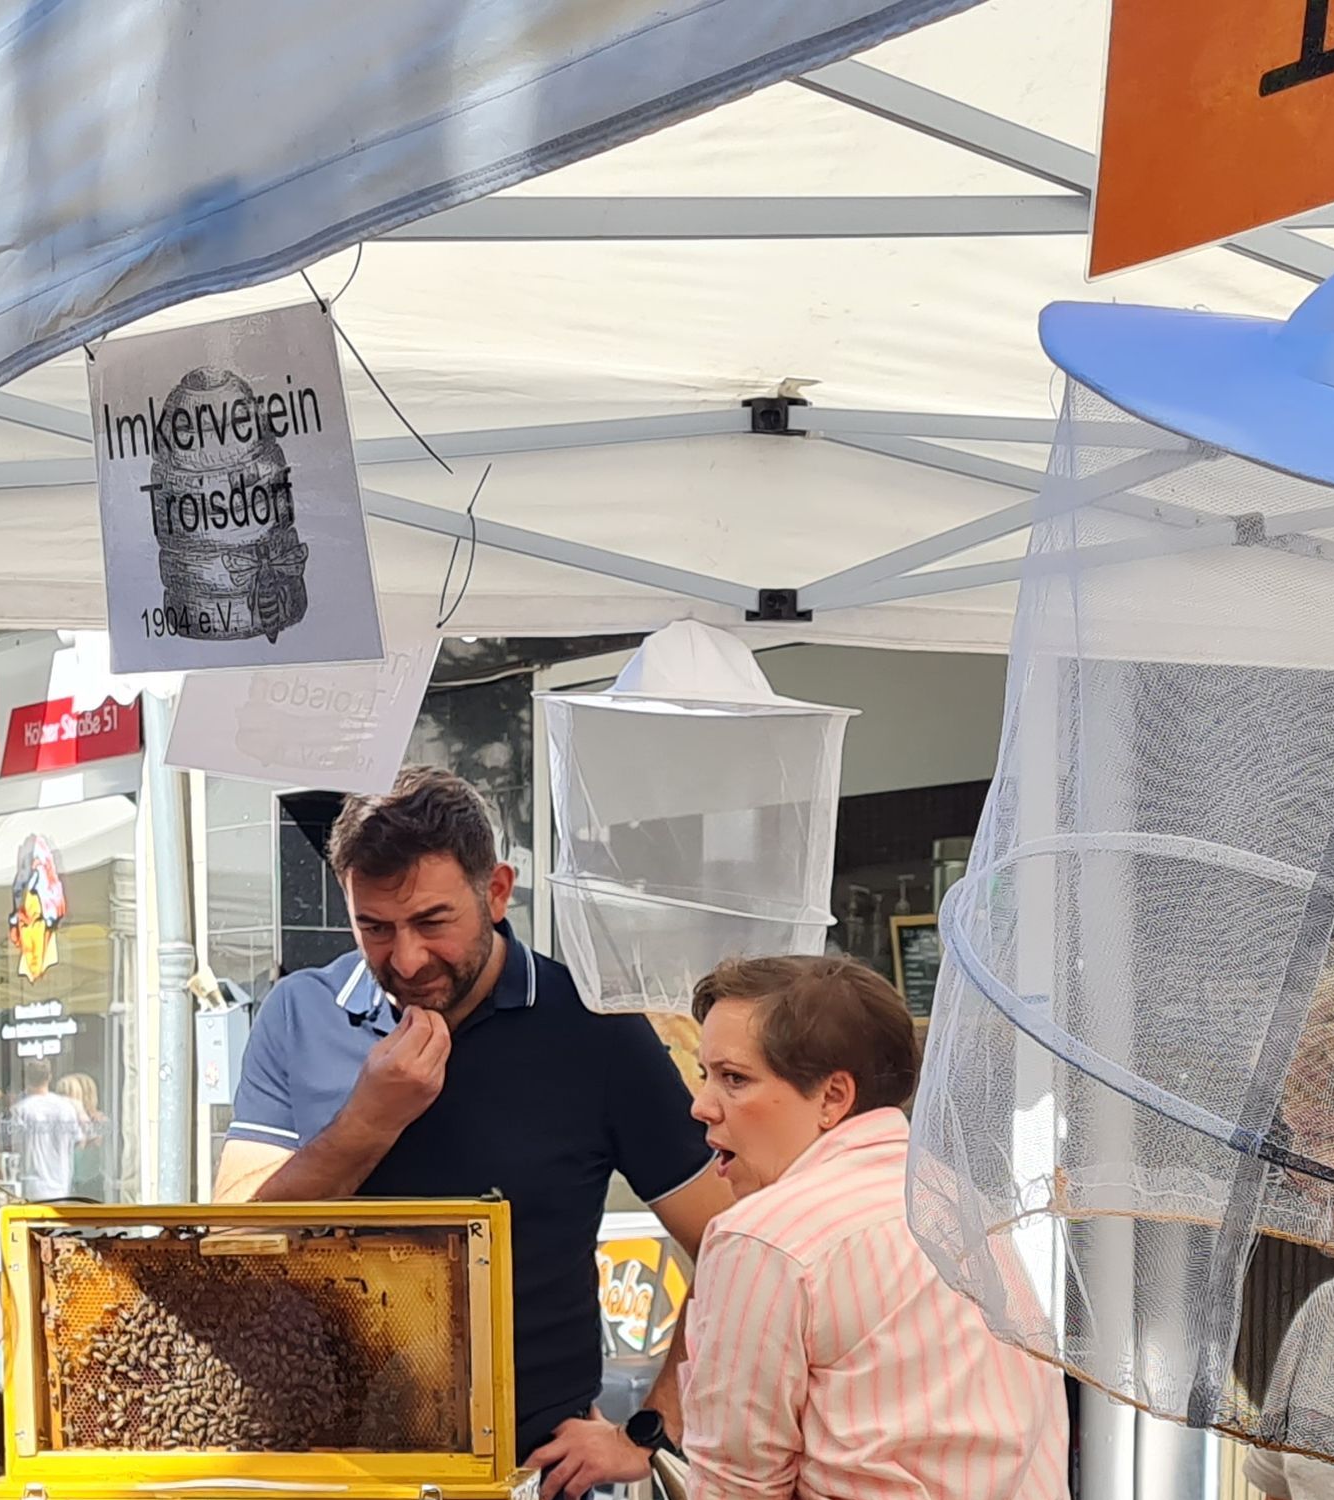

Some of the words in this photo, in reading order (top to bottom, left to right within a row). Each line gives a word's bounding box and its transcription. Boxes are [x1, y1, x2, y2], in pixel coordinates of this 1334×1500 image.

[104, 375, 322, 461] Imkerverein
[140, 466, 294, 537] Troisdorf
[140, 607, 194, 639] 1904
[198, 602, 239, 634] e.V.
[103, 704, 119, 732] 51
[469, 1221, 484, 1239] R
